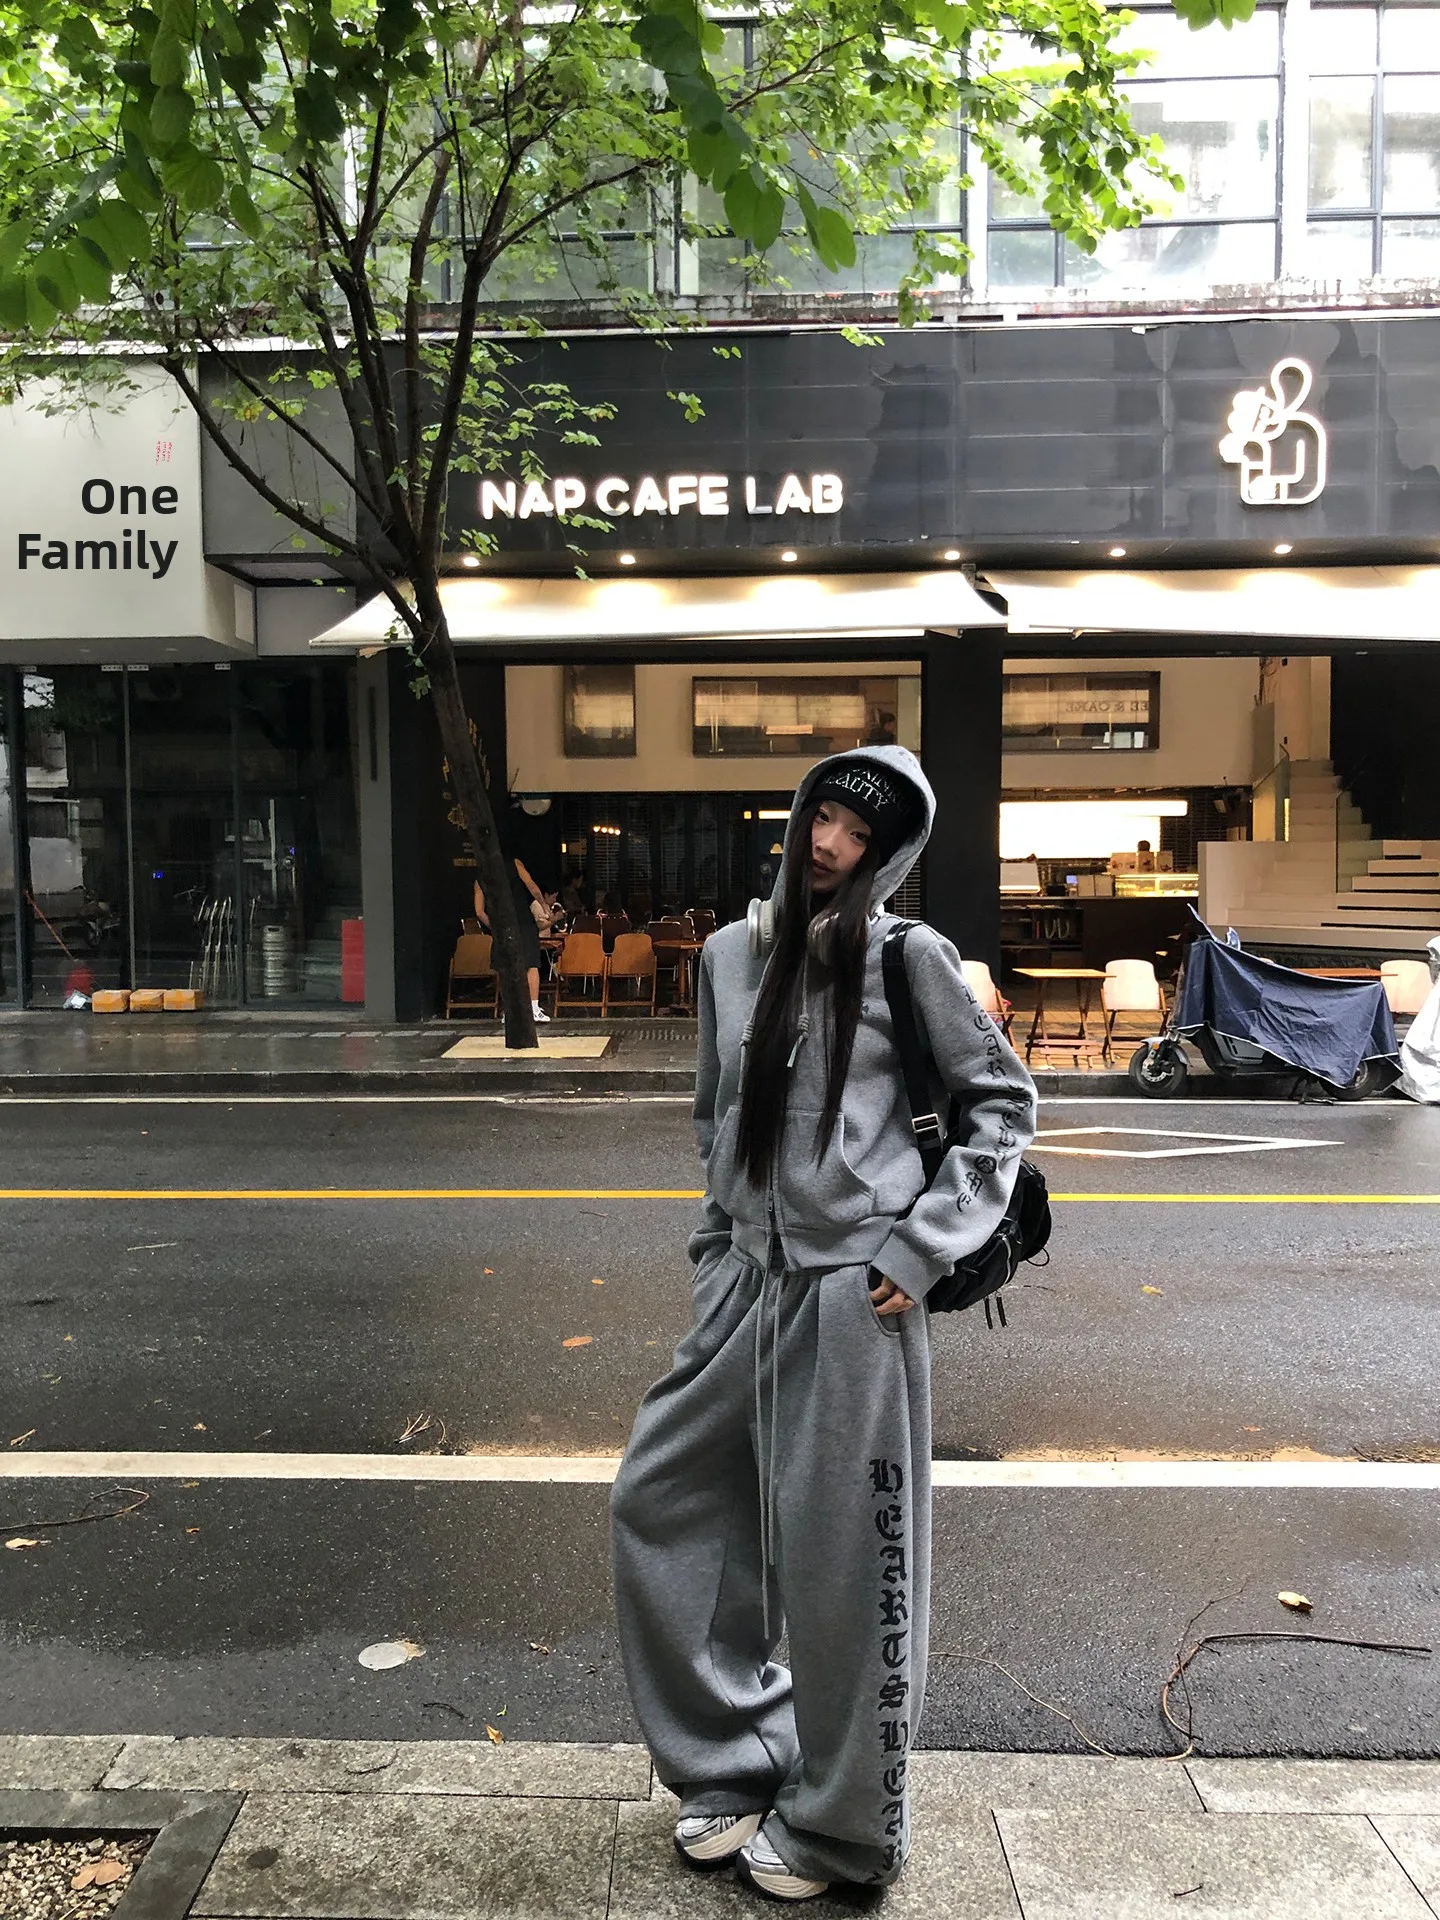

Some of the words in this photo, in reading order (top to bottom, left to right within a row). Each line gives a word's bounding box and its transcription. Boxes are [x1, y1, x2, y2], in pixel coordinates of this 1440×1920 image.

[81, 478, 178, 515] One
[480, 477, 586, 519] NAP
[595, 475, 730, 517] CAFE
[746, 474, 844, 515] LAB
[18, 529, 178, 579] Family
